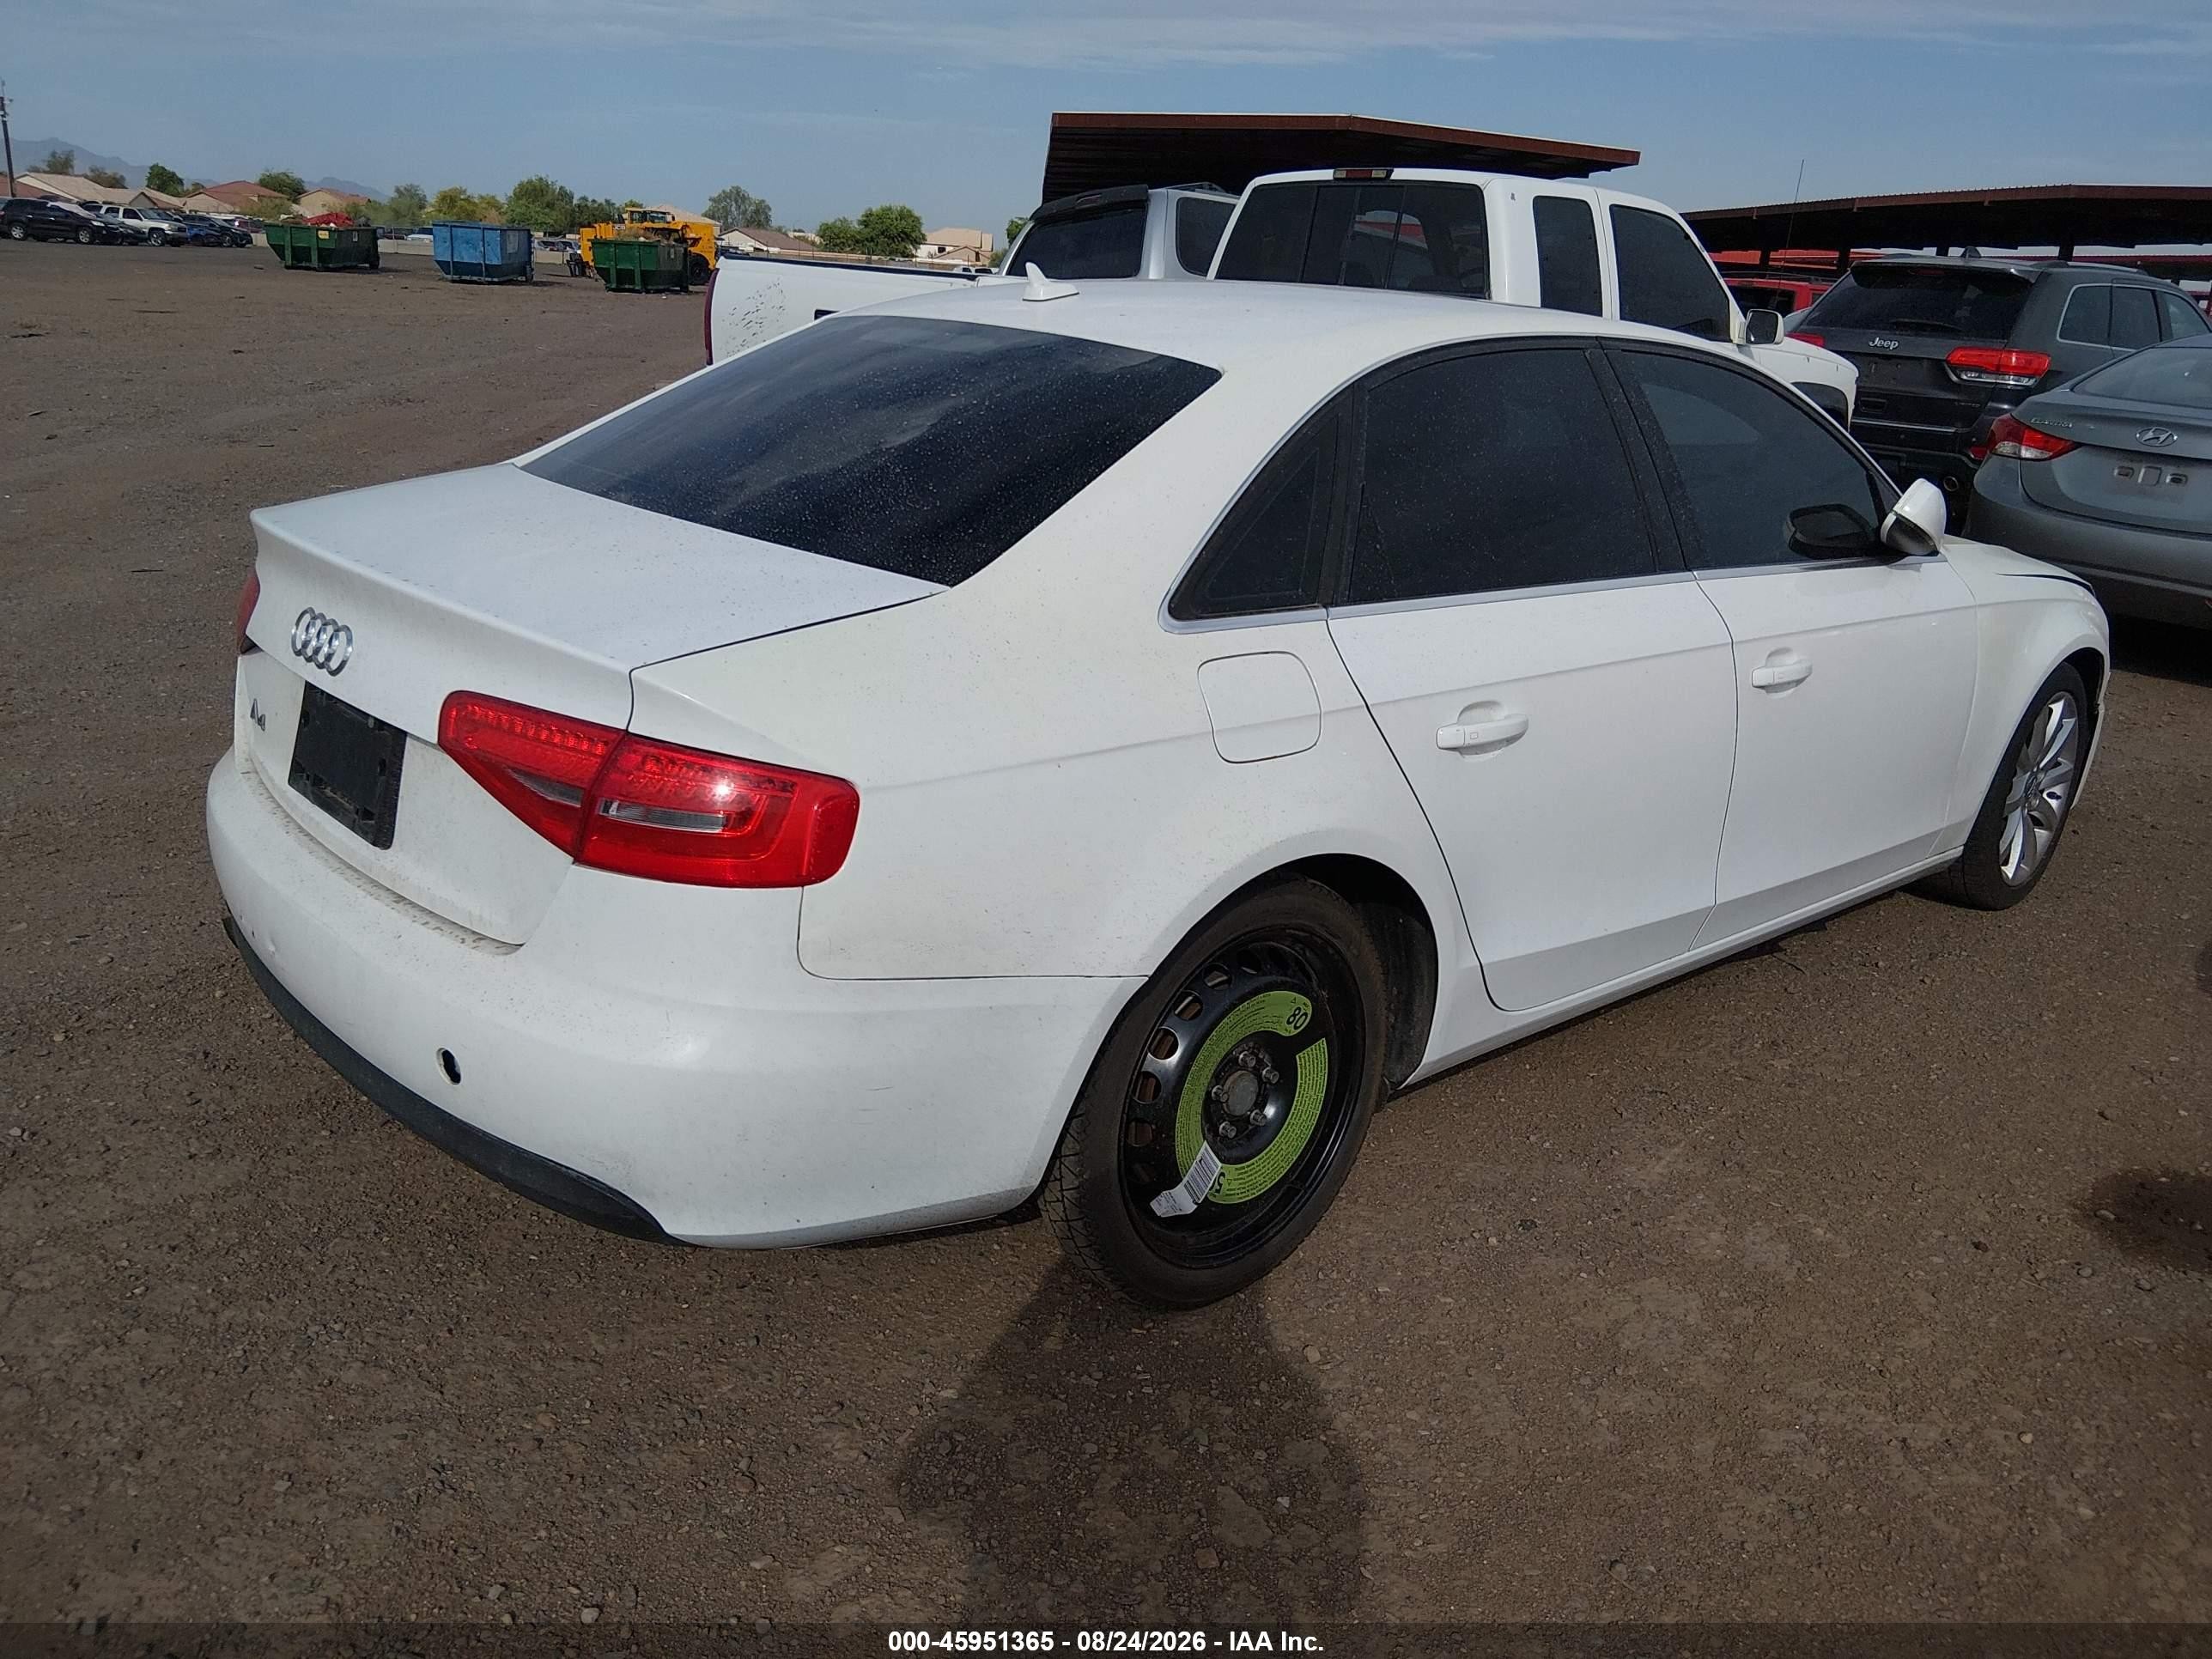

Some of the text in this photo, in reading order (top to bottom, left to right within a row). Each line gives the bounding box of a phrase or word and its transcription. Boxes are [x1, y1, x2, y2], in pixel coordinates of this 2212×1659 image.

[1869, 337, 1899, 349] Jeep
[250, 698, 266, 732] A4
[1286, 1006, 1309, 1030] 80
